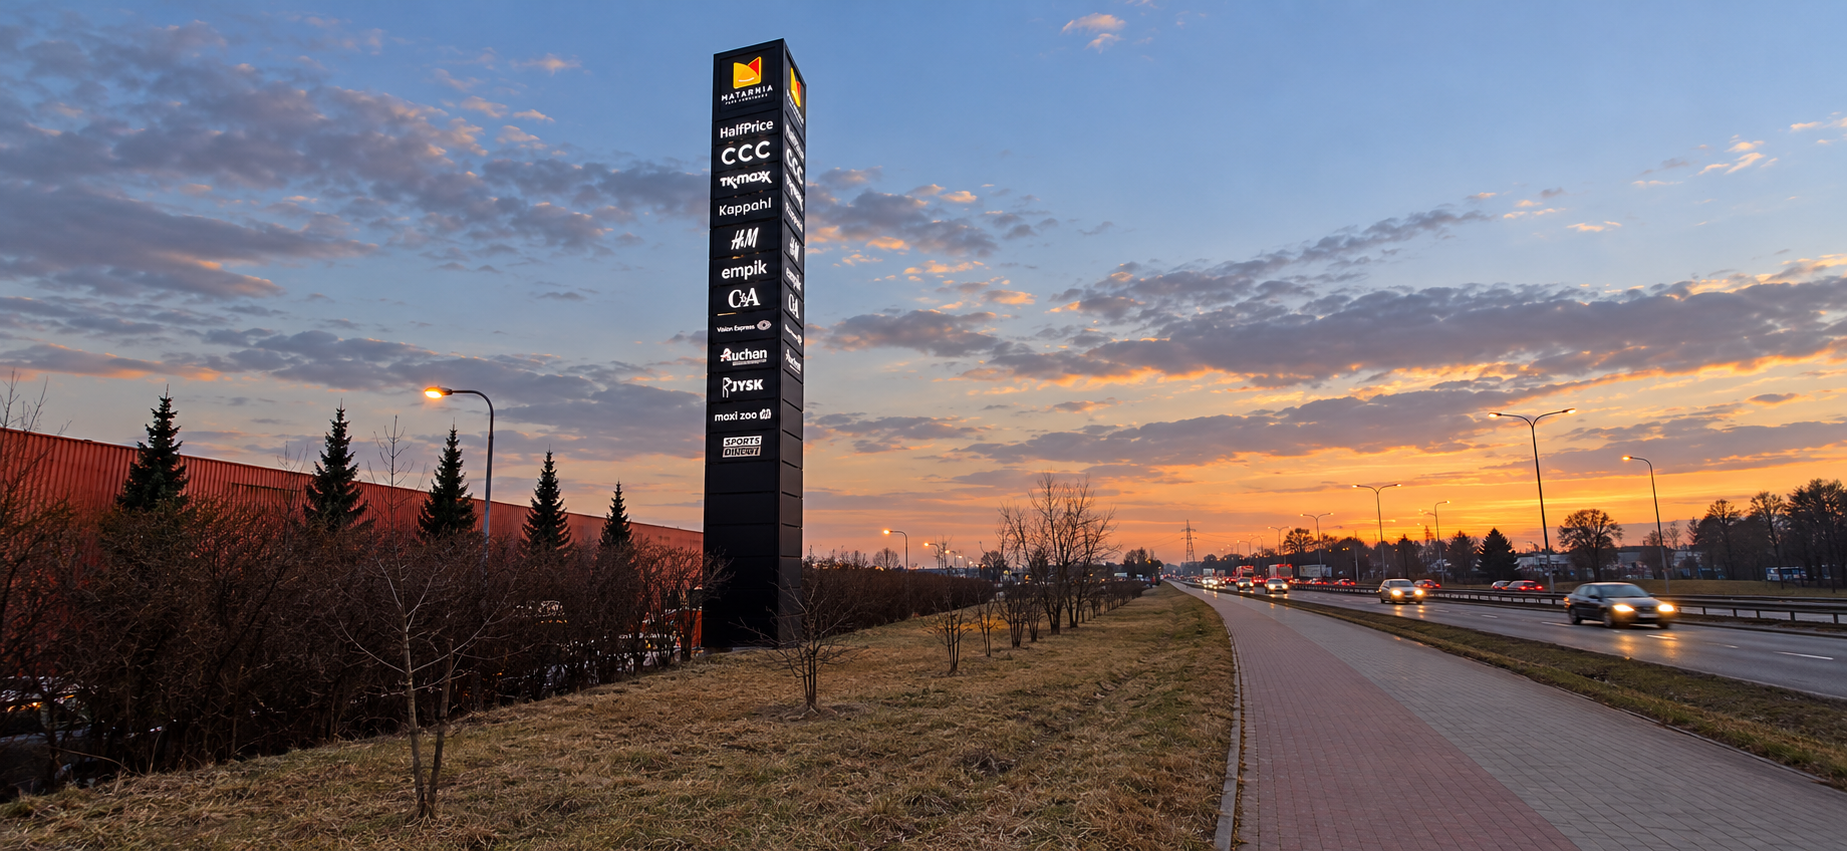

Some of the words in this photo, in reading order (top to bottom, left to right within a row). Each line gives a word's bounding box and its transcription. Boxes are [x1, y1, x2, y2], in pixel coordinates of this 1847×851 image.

[720, 120, 774, 139] HalfPrice
[721, 140, 771, 165] CCC
[786, 148, 804, 185] CCC
[719, 197, 772, 217] Kappahl
[730, 227, 759, 250] H&M
[721, 260, 768, 280] empik
[728, 287, 761, 309] C&A
[734, 324, 756, 333] Express
[720, 347, 768, 362] Auchan
[730, 378, 764, 392] JYSK
[739, 412, 757, 420] zoo
[725, 437, 760, 446] SPORTS
